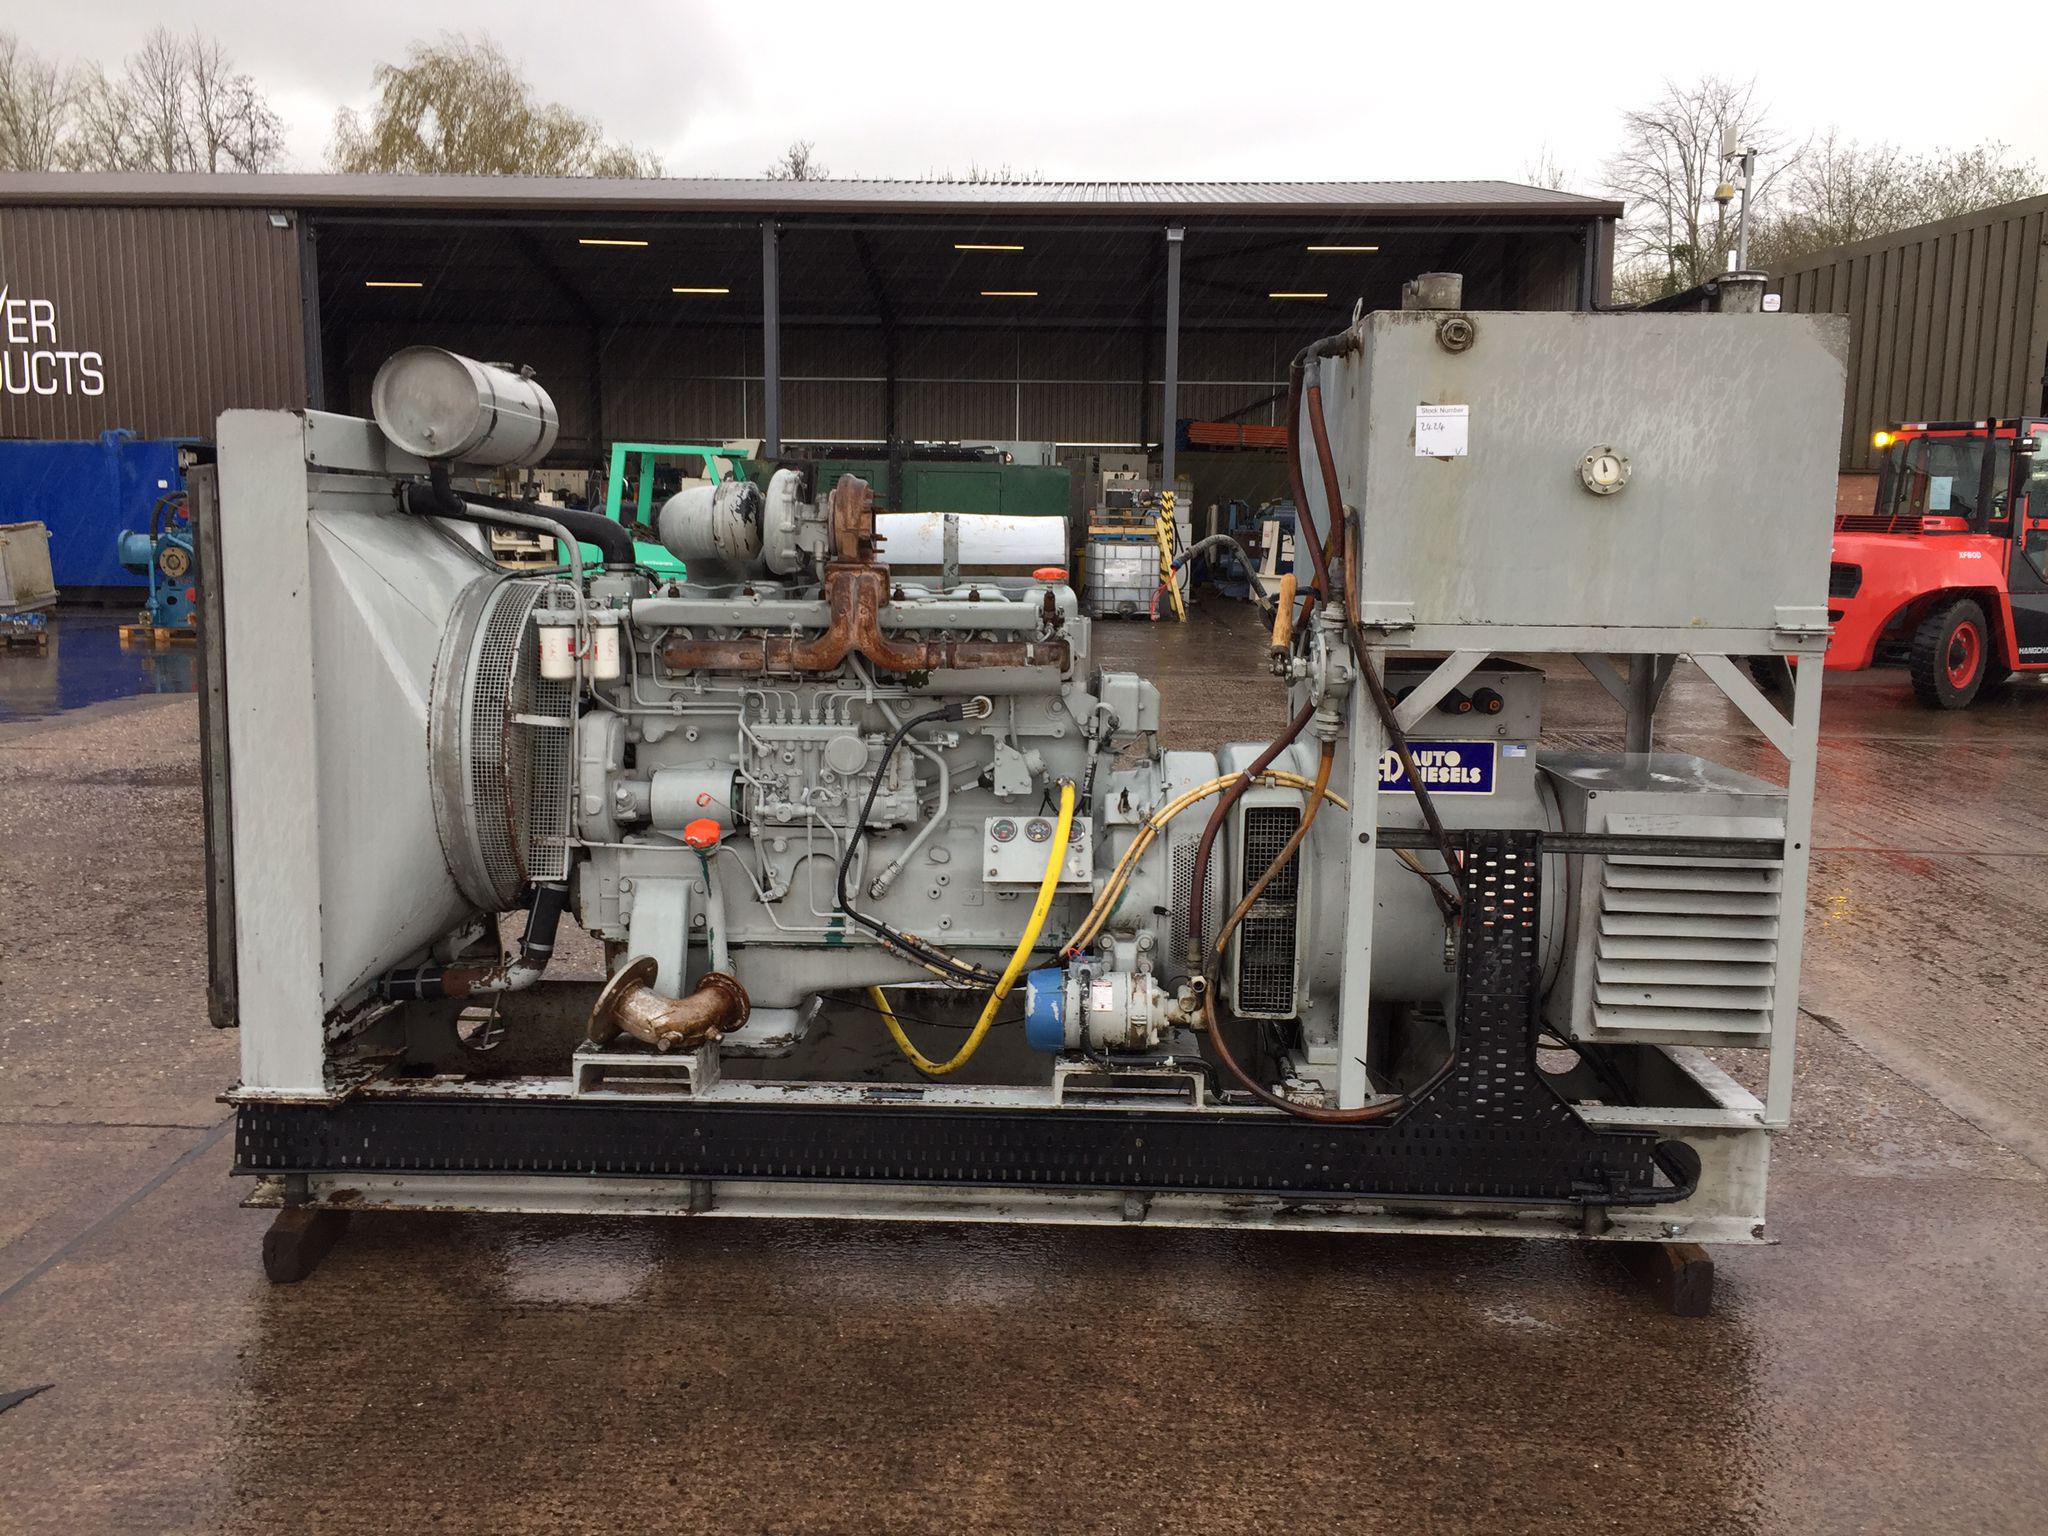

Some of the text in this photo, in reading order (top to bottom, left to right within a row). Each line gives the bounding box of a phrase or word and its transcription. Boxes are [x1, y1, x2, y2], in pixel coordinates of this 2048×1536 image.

[0, 350, 104, 396] UCTS
[1412, 750, 1461, 767] AUTO
[1408, 766, 1482, 783] IESELS
